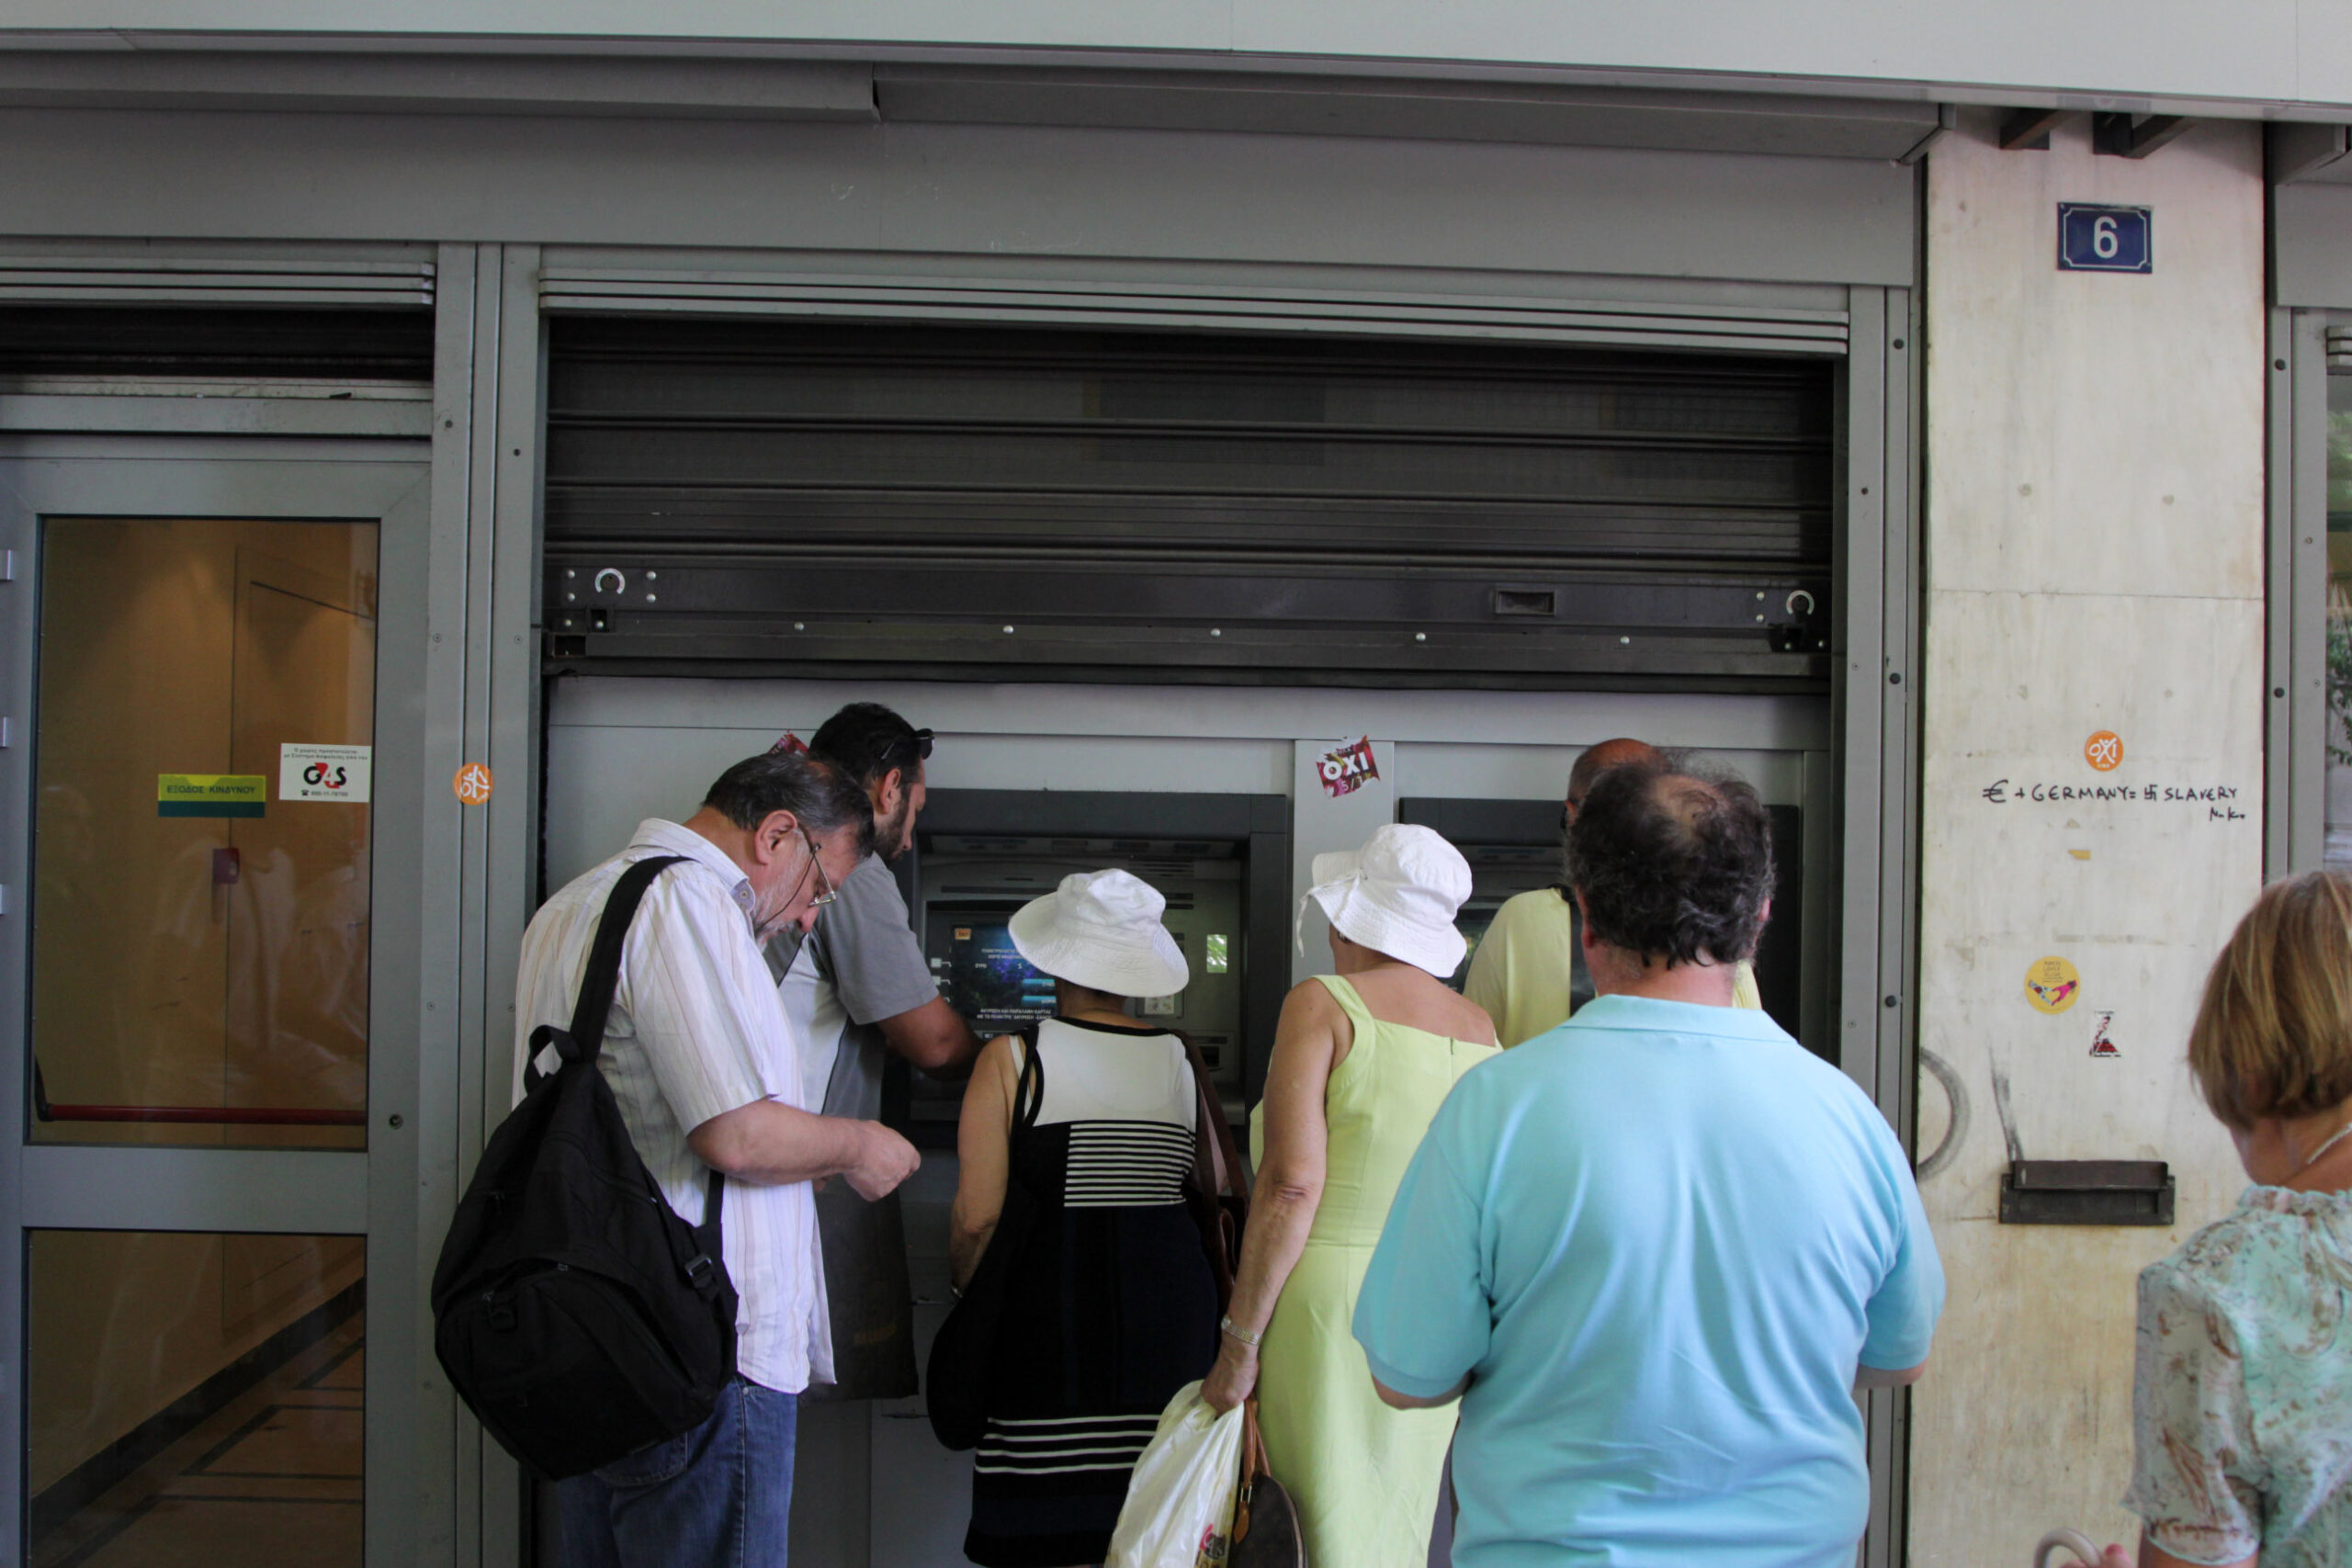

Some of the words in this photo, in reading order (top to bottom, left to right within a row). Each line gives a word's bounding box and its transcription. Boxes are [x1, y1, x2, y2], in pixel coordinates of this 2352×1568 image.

[2094, 216, 2118, 259] 6
[303, 761, 347, 789] G4S
[1323, 751, 1370, 781] ΟΧΙ
[166, 785, 205, 794] ΕΞΟΔΟΣ
[209, 785, 256, 795] ΚΙΝΔΥΝΟΥ
[2164, 785, 2237, 802] SLAVERY
